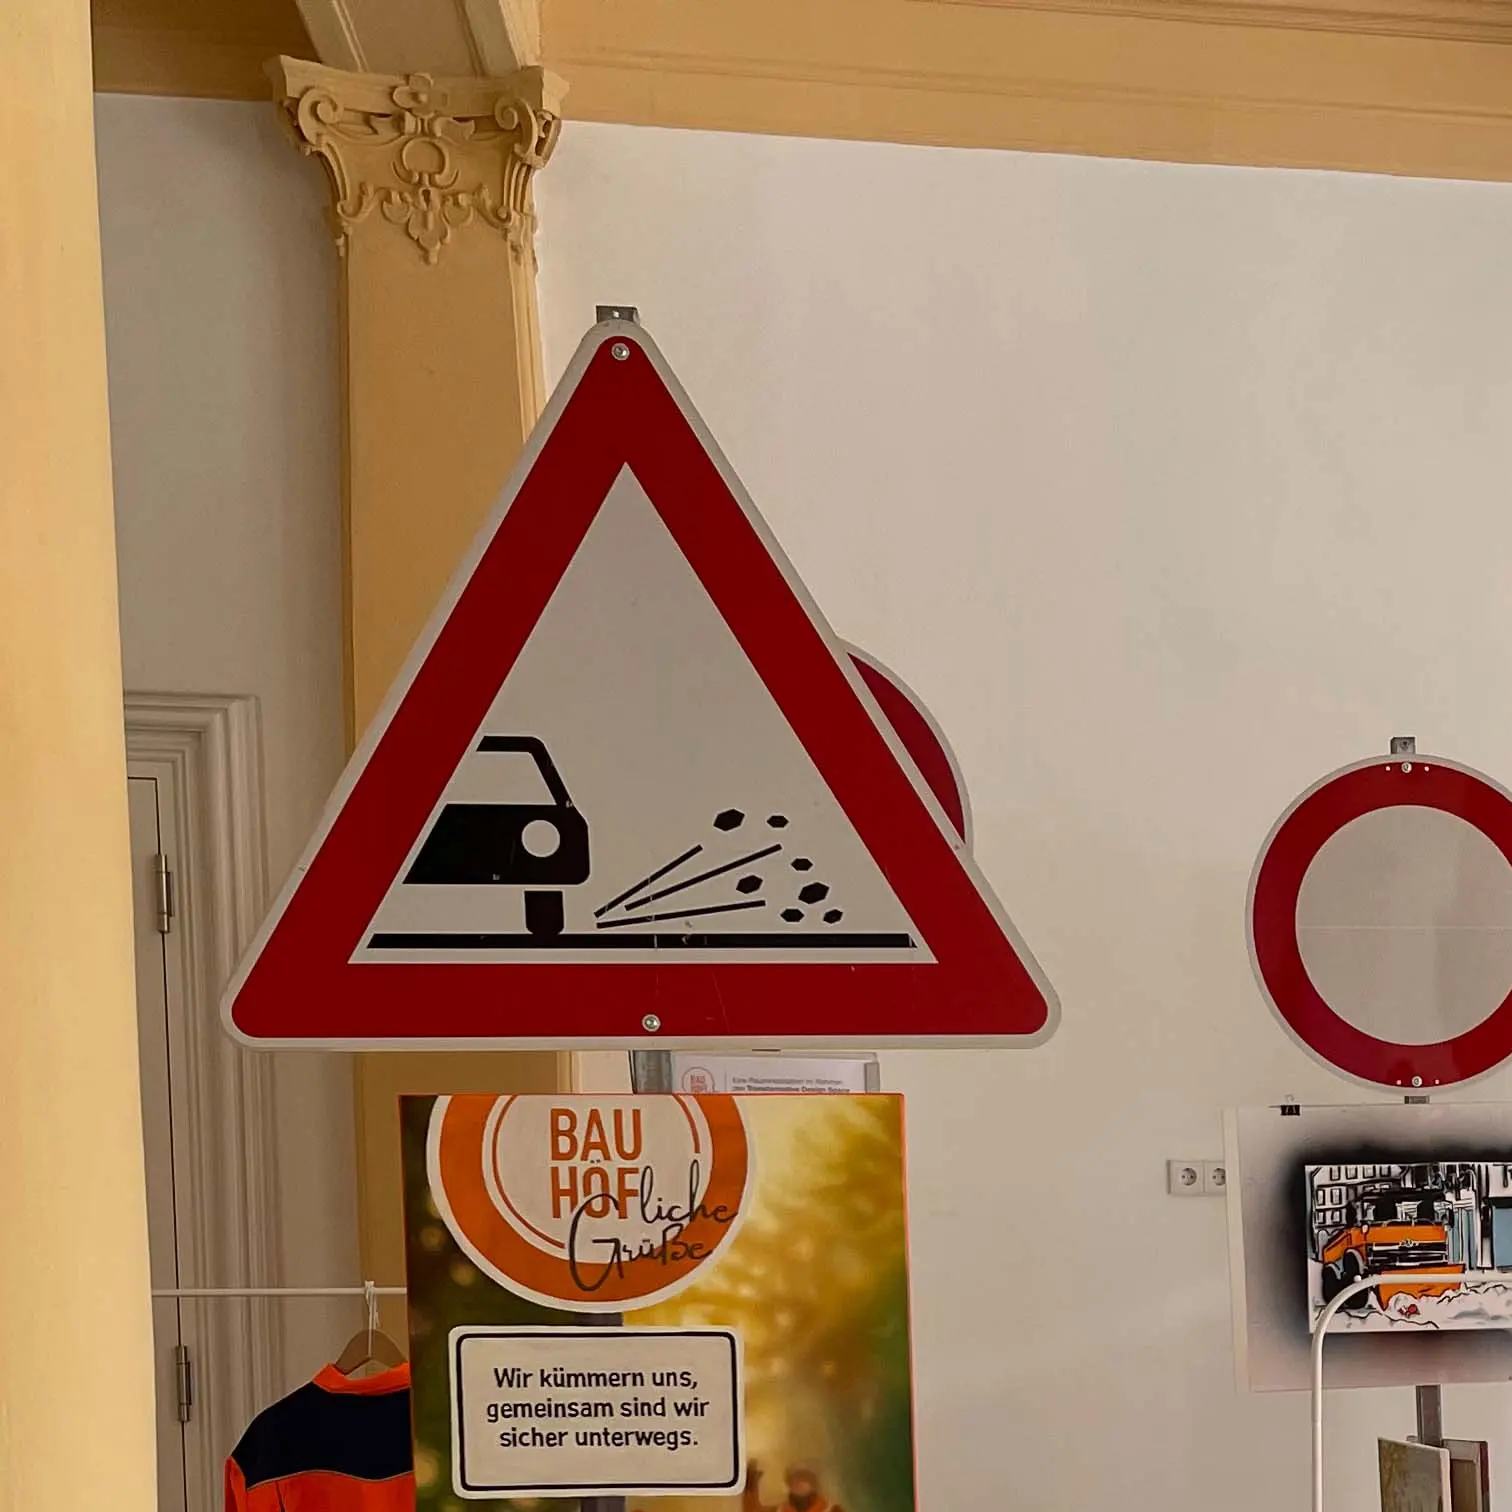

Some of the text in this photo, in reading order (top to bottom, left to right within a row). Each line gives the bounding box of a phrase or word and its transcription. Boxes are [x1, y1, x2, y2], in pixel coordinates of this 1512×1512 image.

[549, 1107, 643, 1162] BAU
[568, 1192, 714, 1292] Grüße
[493, 1366, 698, 1390] Wir kümmern uns,
[486, 1397, 710, 1424] gemeinsam sind wir
[499, 1426, 699, 1452] sicher unterwegs.
